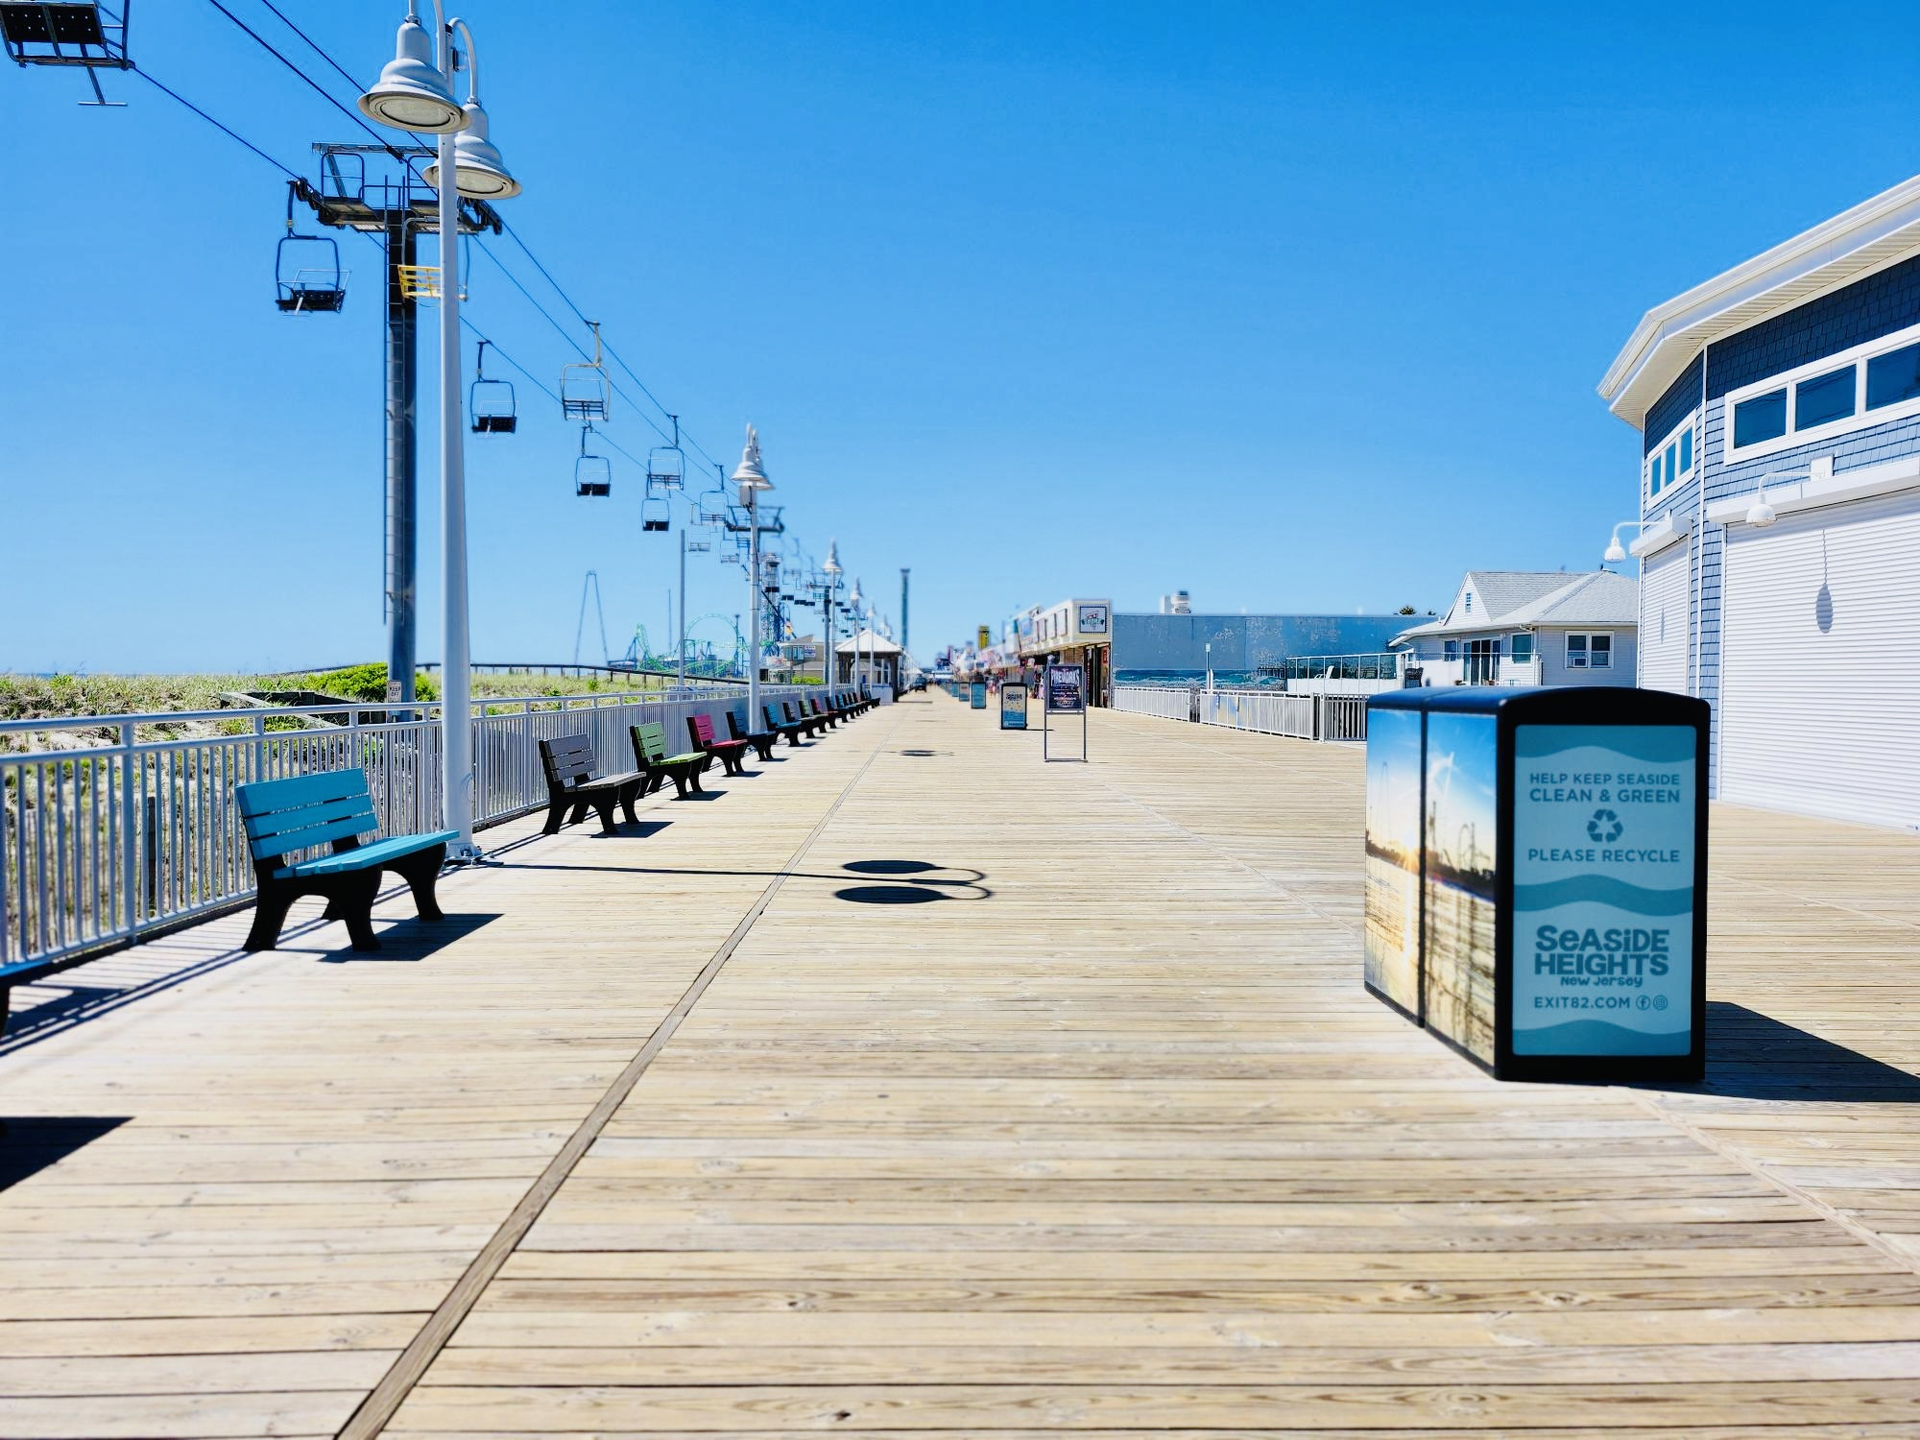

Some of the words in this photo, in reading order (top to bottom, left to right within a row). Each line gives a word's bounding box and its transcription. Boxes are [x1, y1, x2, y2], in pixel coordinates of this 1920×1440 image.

[1529, 773, 1568, 784] HELP
[1573, 773, 1612, 785] KEEP
[1617, 774, 1681, 786] SEASIDE
[1529, 788, 1593, 802] CLEAN
[1599, 789, 1611, 803] &
[1617, 789, 1681, 803] GREEN
[1528, 849, 1596, 862] PLEASE
[1602, 850, 1681, 863] RECYCLE
[1534, 953, 1669, 976] HEIGHTS
[1560, 976, 1591, 987] New
[1593, 976, 1644, 988] Jersey
[1534, 996, 1630, 1009] EXIT82.COM
